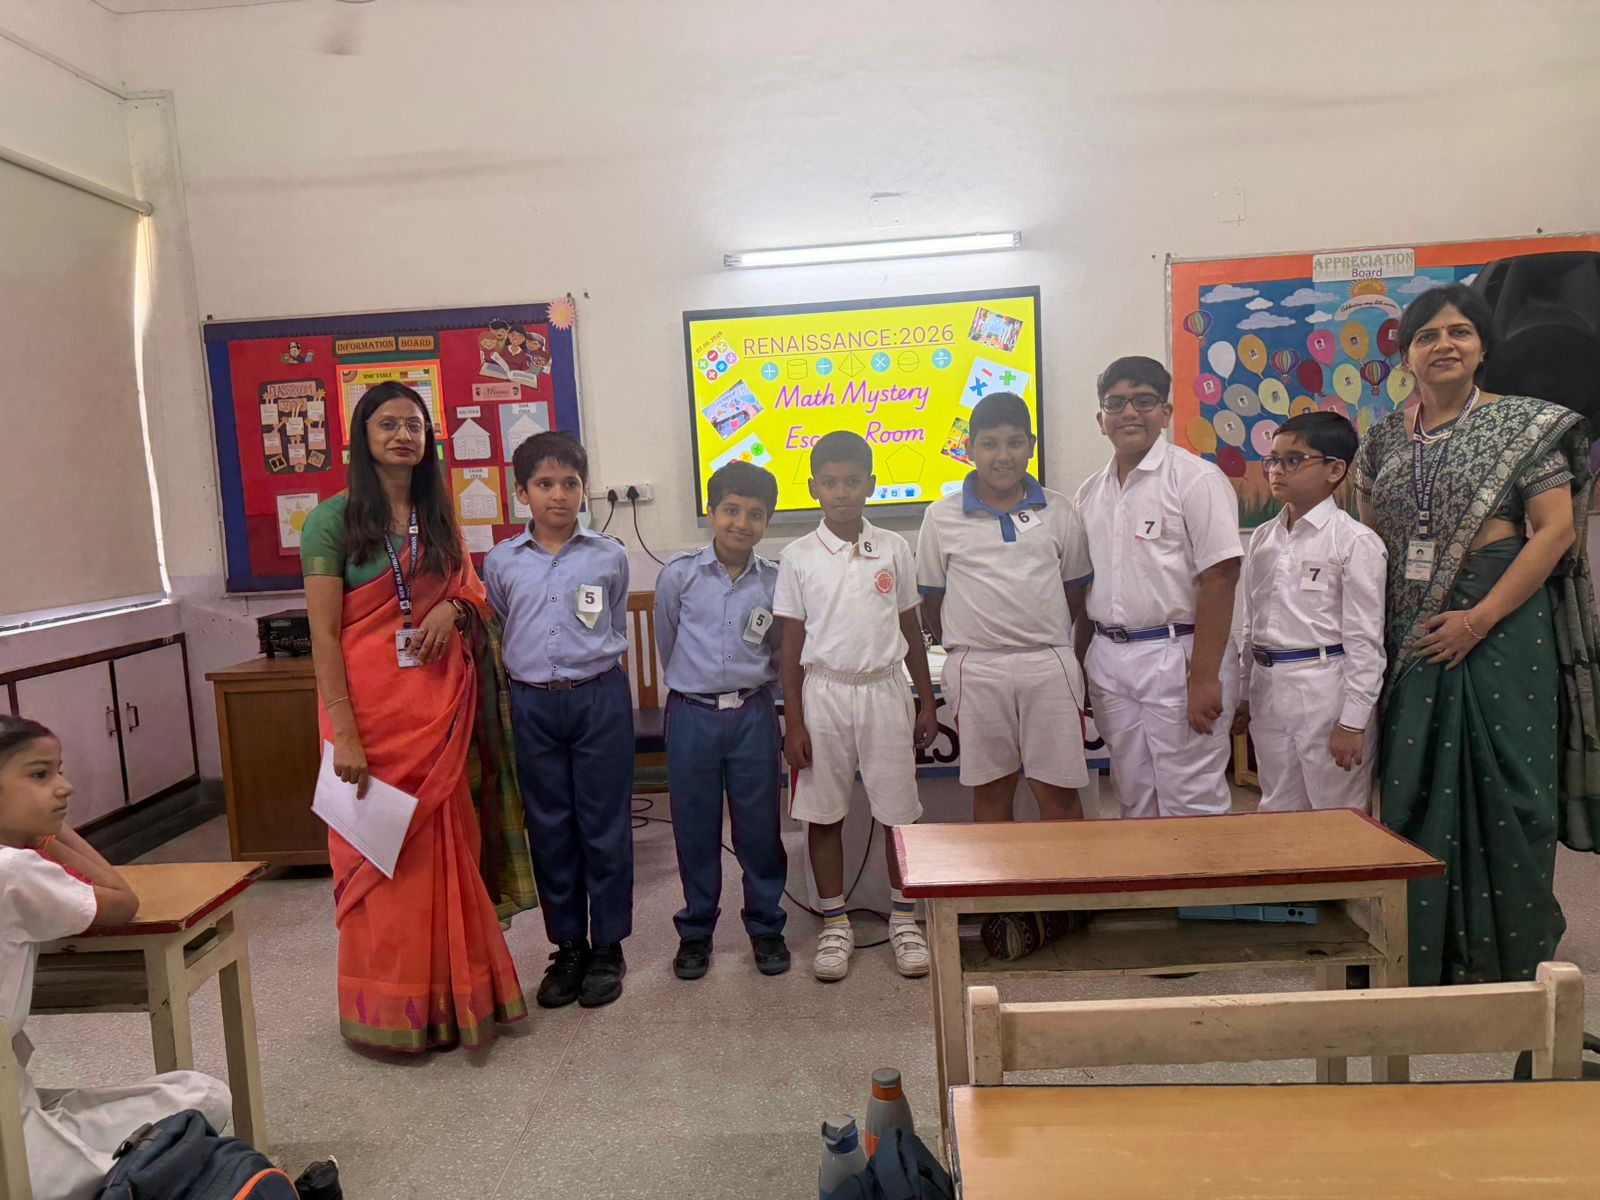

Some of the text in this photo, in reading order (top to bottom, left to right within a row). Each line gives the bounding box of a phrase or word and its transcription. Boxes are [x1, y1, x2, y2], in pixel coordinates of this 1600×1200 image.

[1314, 252, 1413, 270] APPRECIATION
[1352, 268, 1383, 277] Board
[337, 339, 431, 352] INFORMATION BOARD
[744, 324, 955, 356] RENAISSANCE:2026
[269, 383, 313, 397] CLASSROOM
[774, 383, 836, 411] Math
[840, 380, 930, 414] Mystery
[864, 421, 926, 445] Room
[1018, 511, 1029, 523] 6
[1144, 521, 1154, 534] 7
[864, 541, 873, 553] 6
[1309, 567, 1320, 582] 7
[584, 592, 596, 605] 5
[755, 613, 765, 627] 5
